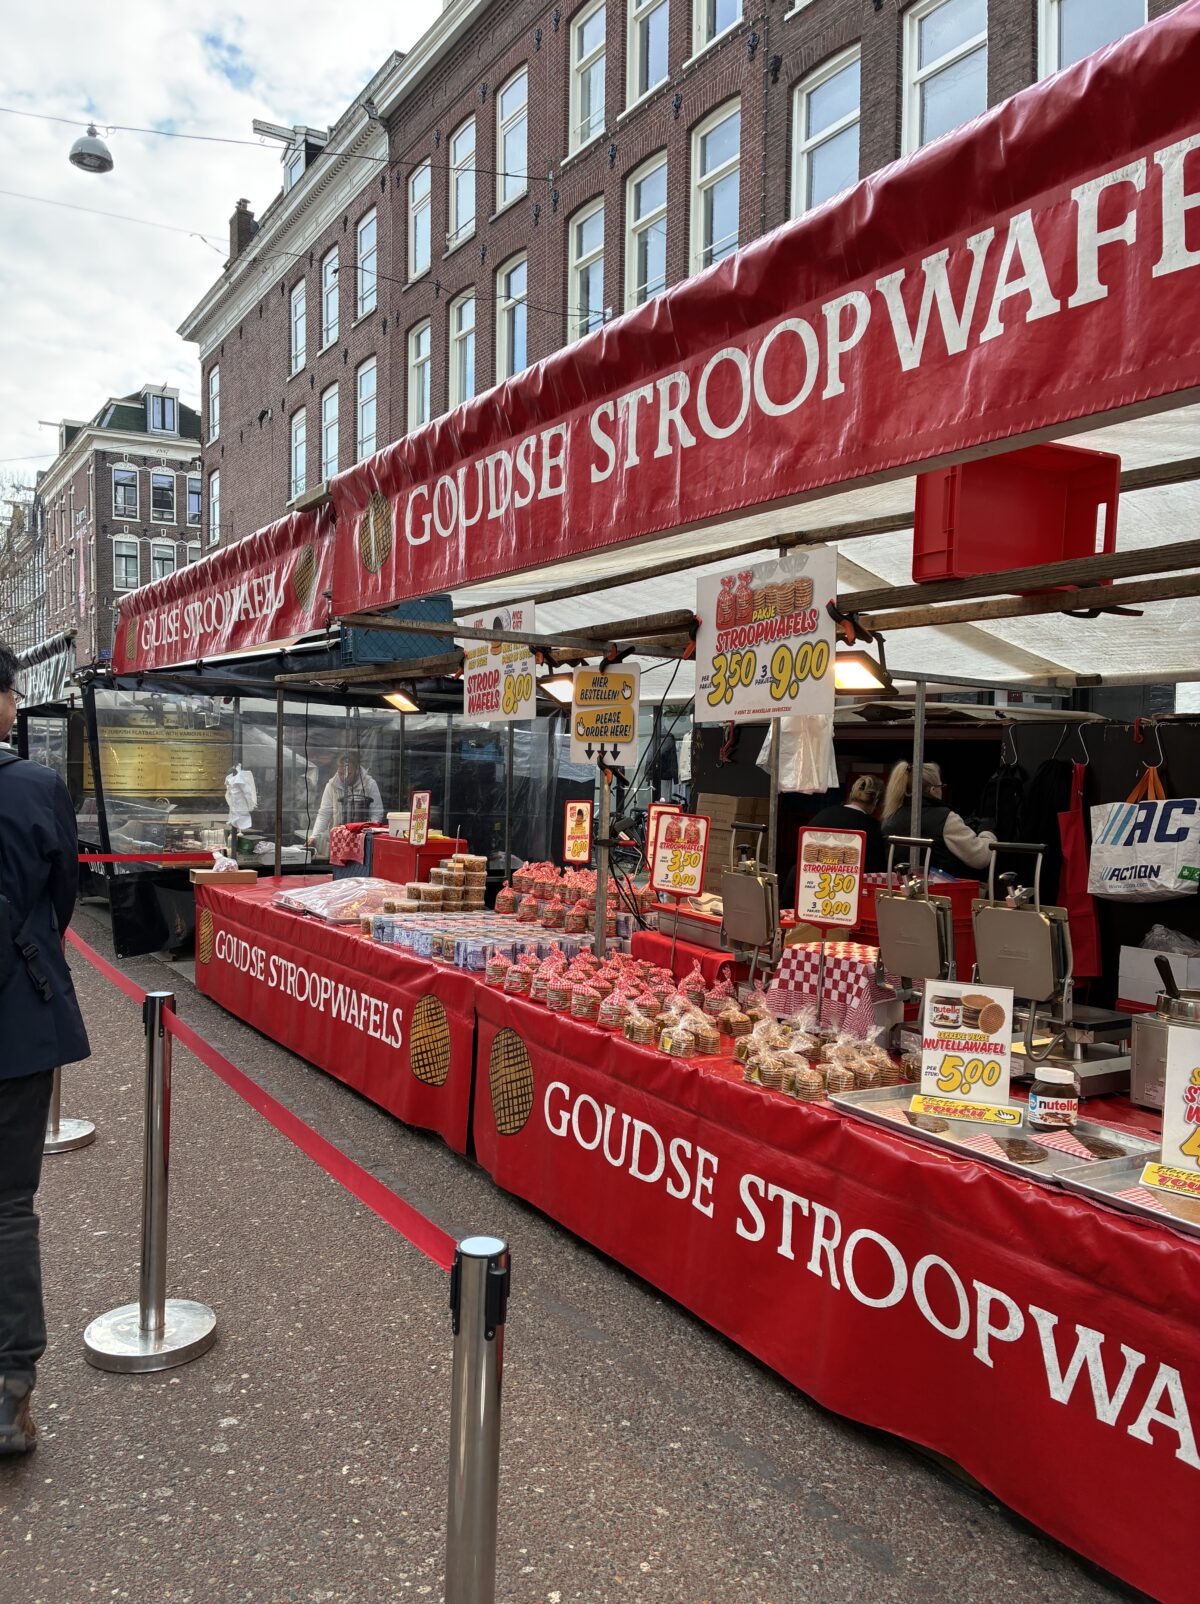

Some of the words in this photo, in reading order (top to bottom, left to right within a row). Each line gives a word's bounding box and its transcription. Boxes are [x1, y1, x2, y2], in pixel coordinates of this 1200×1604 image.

[405, 422, 568, 546] GOUDSE
[751, 605, 776, 623] PAKJE
[715, 608, 818, 653] STROOPWAFELS
[707, 649, 757, 706] 3.50
[760, 665, 768, 678] 3
[770, 639, 830, 701] 9.00
[467, 669, 500, 695] STROOP
[591, 676, 609, 688] HIER
[467, 689, 500, 714] WAFELS
[502, 672, 533, 715] 8.00
[580, 688, 620, 700] BESTELLEN!
[595, 711, 622, 725] PLEASE
[585, 726, 609, 737] ORDER
[610, 724, 632, 737] HERE!
[1123, 799, 1200, 846] AC
[667, 849, 701, 872] 3.50
[802, 863, 859, 874] STROOPWAFELS
[671, 871, 697, 887] 9.00
[1108, 864, 1161, 882] ACTION
[814, 872, 856, 900] 3.50
[811, 901, 817, 909] 3
[821, 899, 851, 917] 9.00
[214, 929, 266, 981] GOUDSE
[267, 954, 403, 1049] STROOPWAFELS
[933, 1004, 961, 1014] nutella
[937, 1030, 967, 1041] LEKKERE
[967, 1032, 990, 1041] VERSE
[922, 1038, 1007, 1055] NUTELLAWAFEL
[936, 1053, 1002, 1095] 5.00
[922, 1103, 987, 1119] TOUCH
[543, 1080, 719, 1218] GOUDSE
[735, 1173, 1200, 1471] STROOPWA
